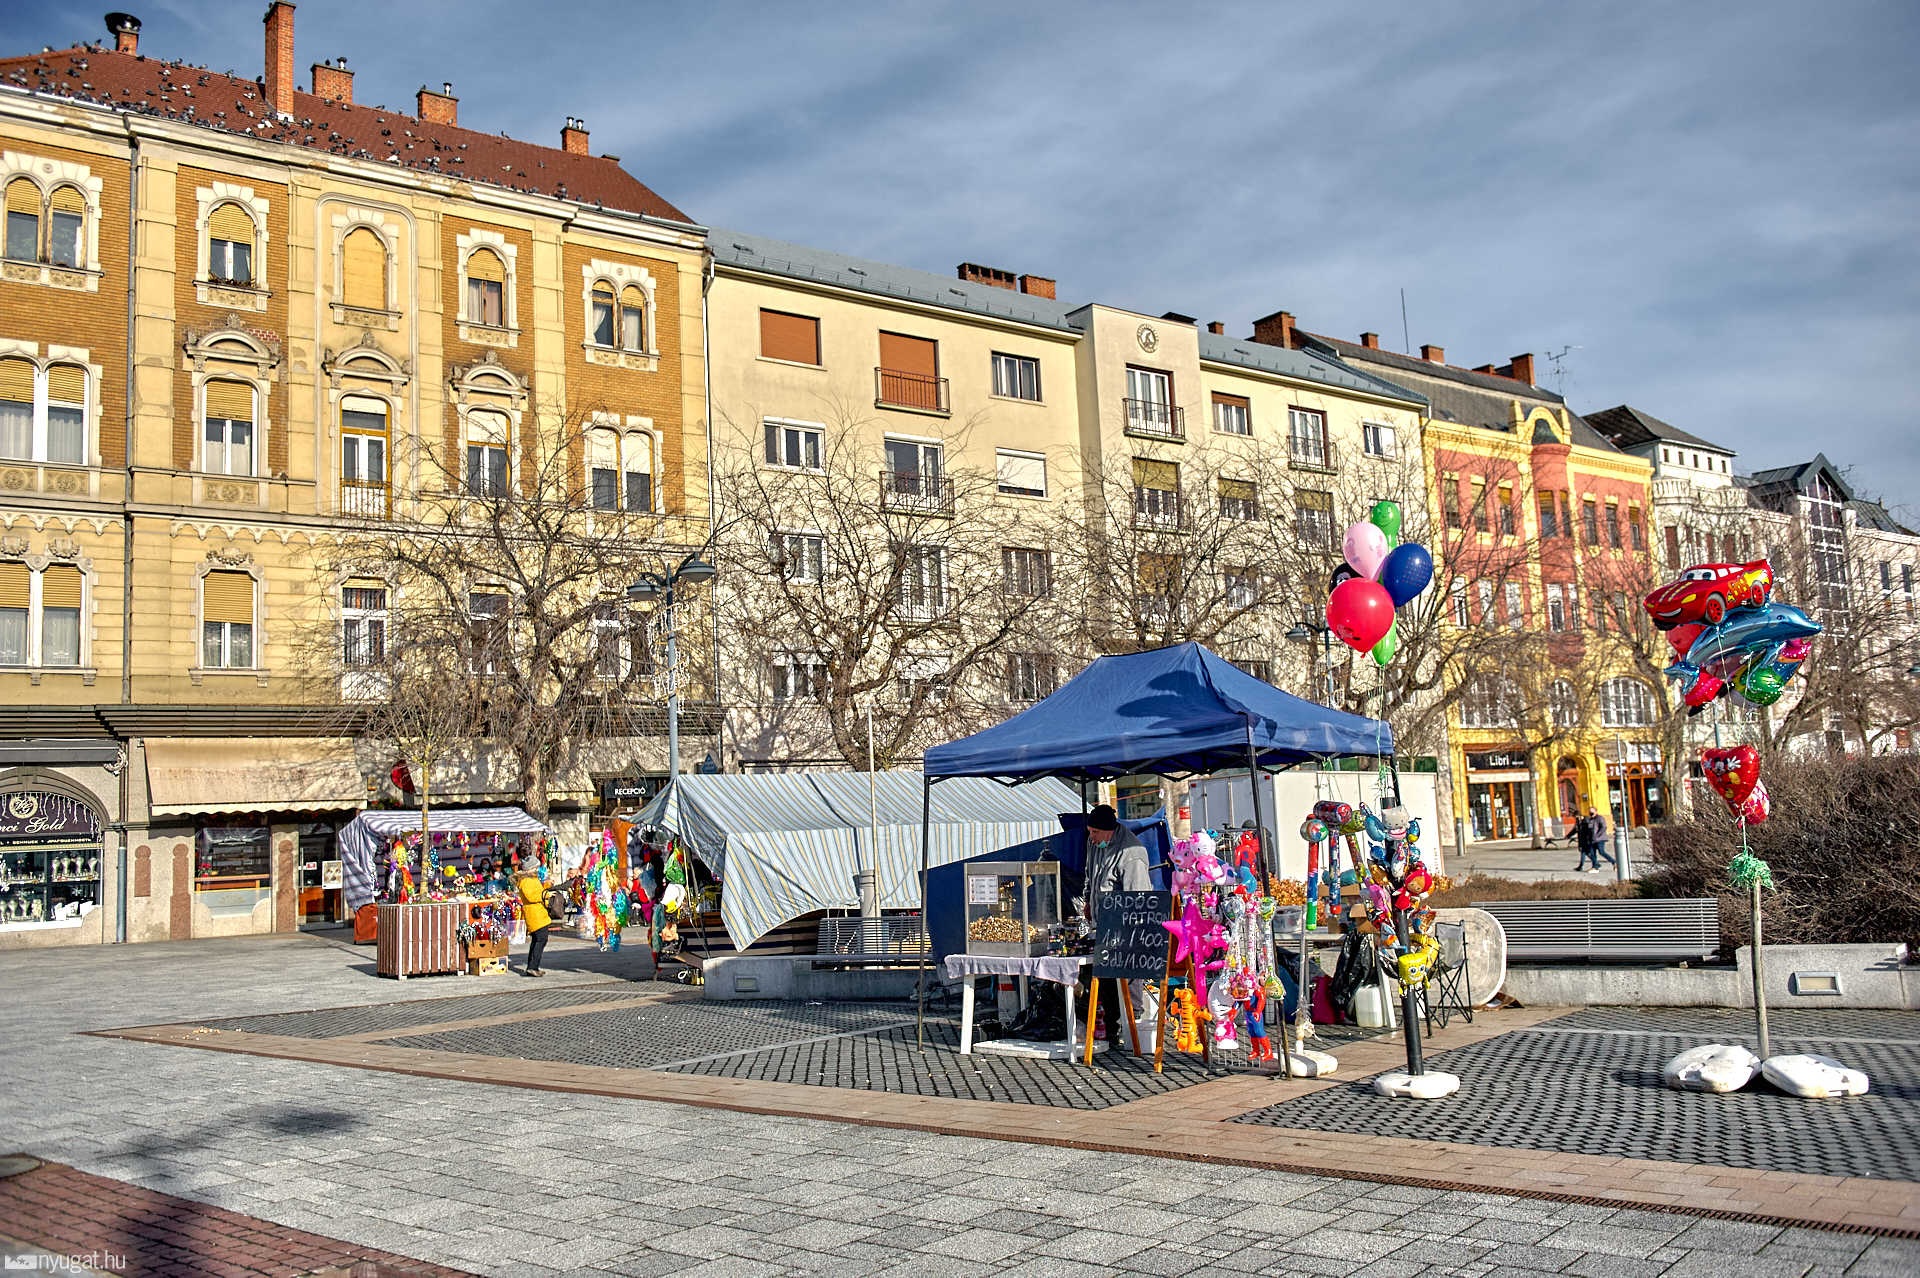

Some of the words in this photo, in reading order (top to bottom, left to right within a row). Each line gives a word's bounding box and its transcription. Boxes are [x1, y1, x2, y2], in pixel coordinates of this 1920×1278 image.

[1489, 754, 1509, 766] Libri
[614, 786, 646, 795] RECEPCIÓ
[25, 816, 67, 833] Gold
[1103, 892, 1159, 911] ÖRDÖG
